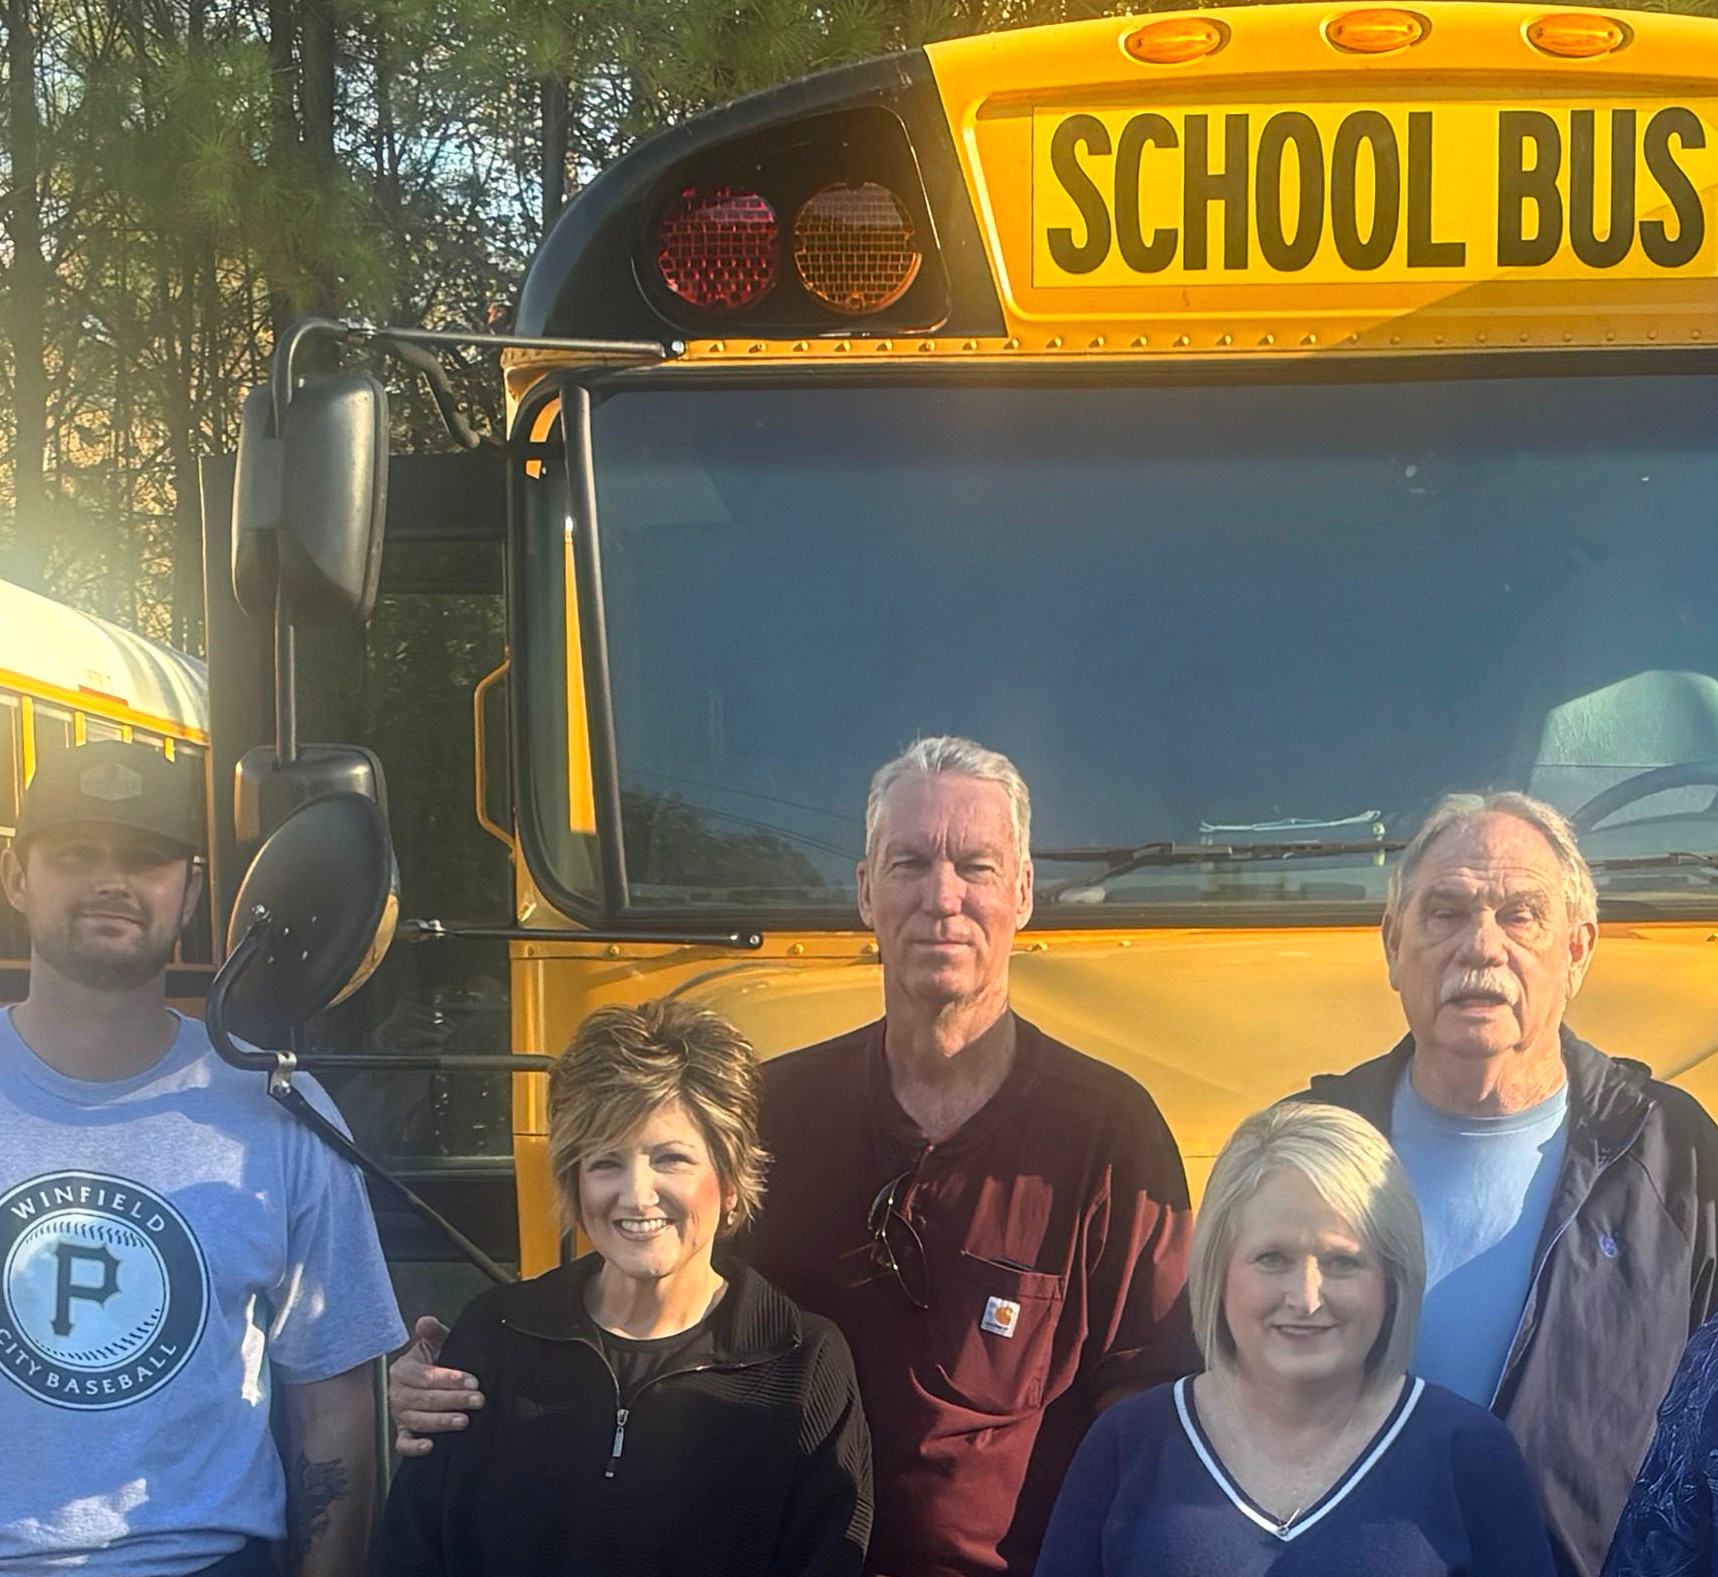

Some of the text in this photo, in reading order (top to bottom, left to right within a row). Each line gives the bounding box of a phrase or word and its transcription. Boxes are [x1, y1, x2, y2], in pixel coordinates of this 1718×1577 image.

[1045, 106, 1708, 275] SCHOOL BUS
[10, 1185, 166, 1233] WINFIELD
[49, 1240, 122, 1338] P
[46, 1345, 177, 1395] BASEBALL
